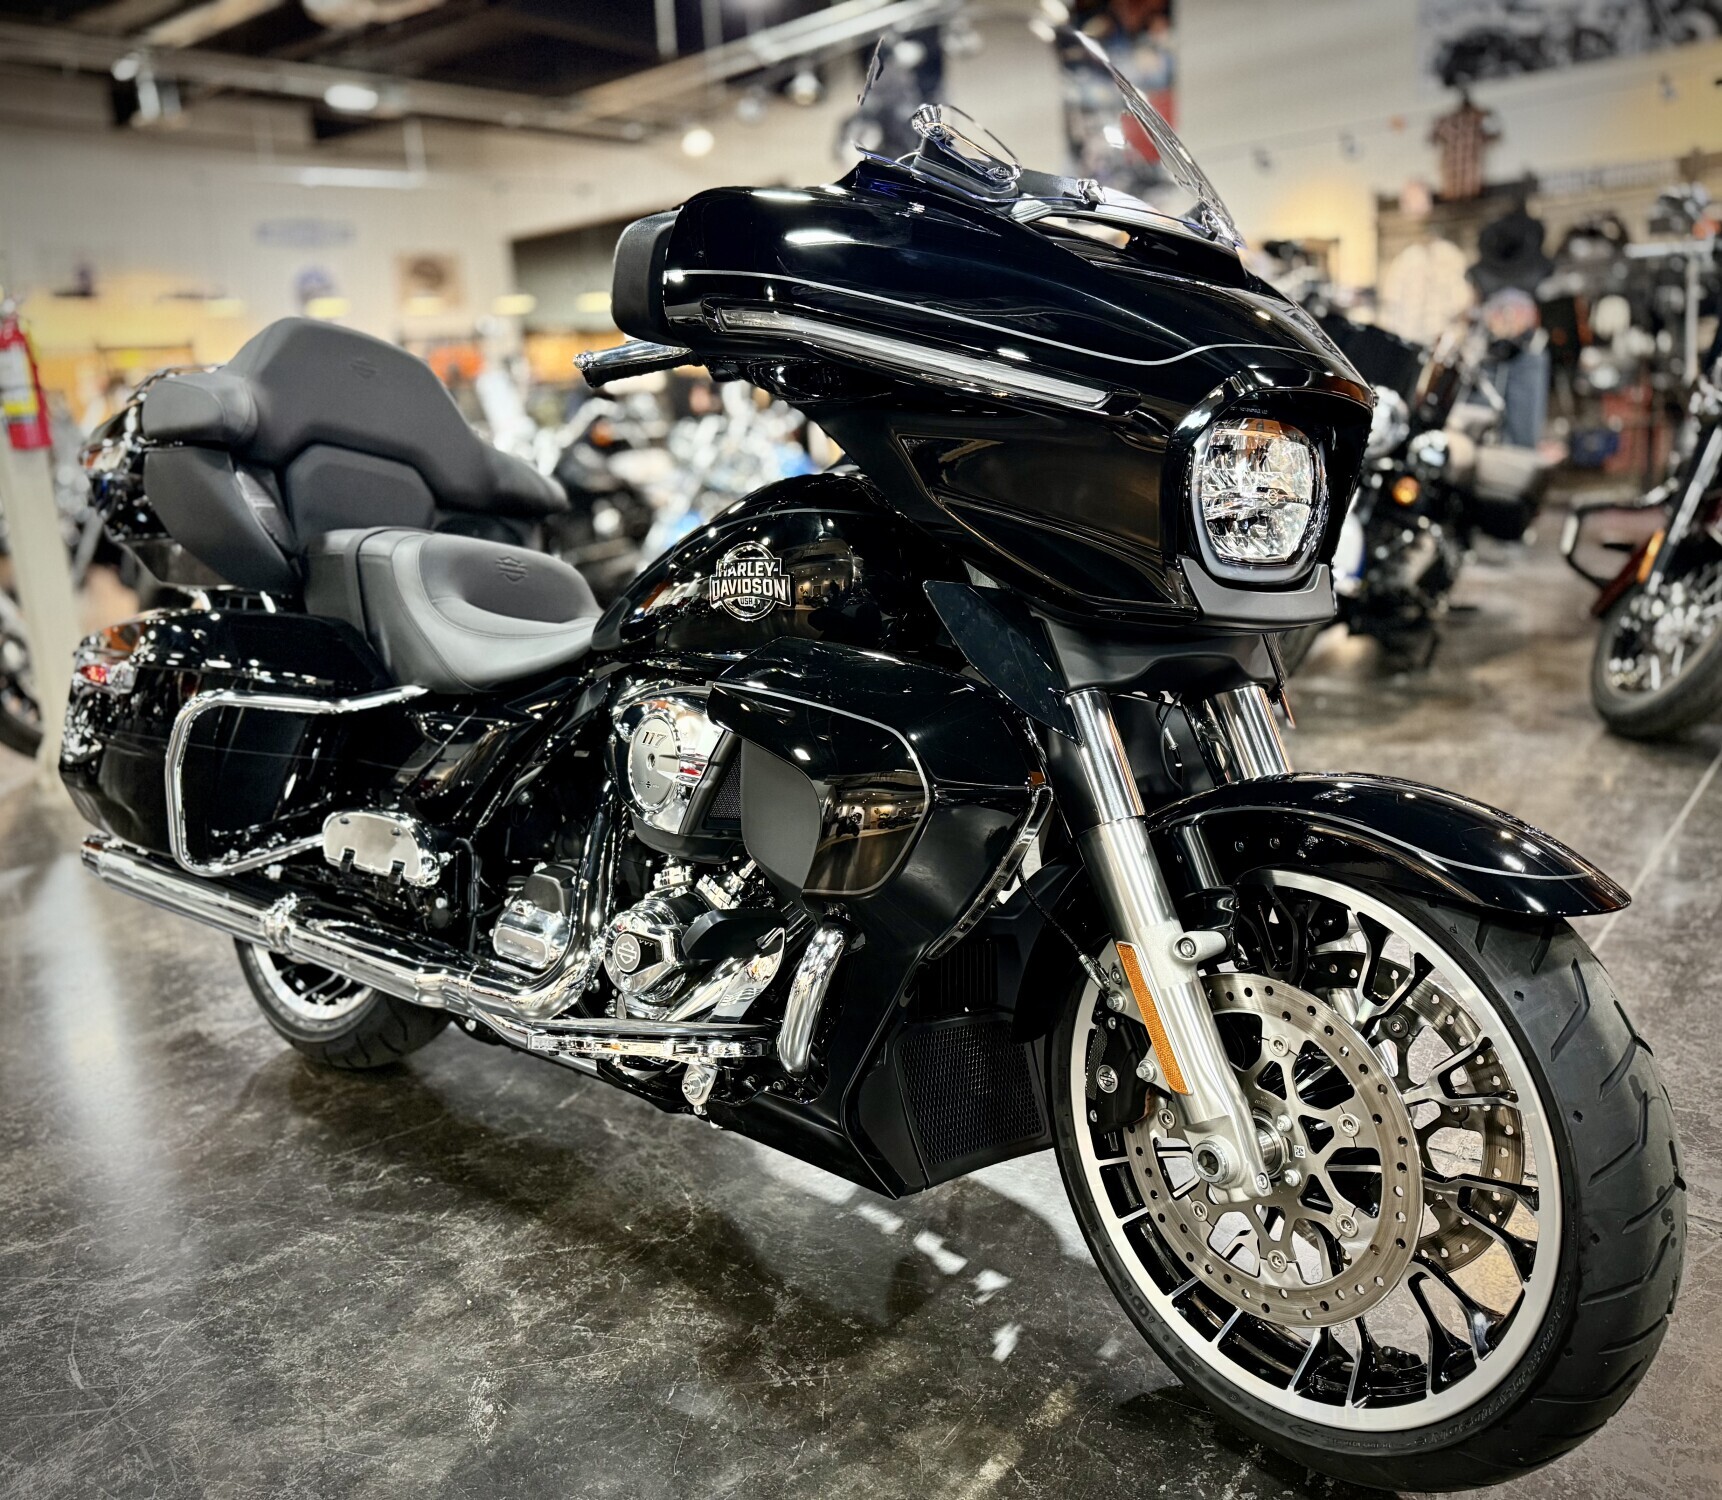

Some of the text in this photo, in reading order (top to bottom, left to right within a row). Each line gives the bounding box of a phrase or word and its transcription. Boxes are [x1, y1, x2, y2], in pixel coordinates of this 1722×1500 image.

[719, 561, 779, 577] HARLEY-
[712, 578, 786, 601] DAVIDSON
[740, 597, 753, 605] USA
[642, 731, 667, 748] 117
